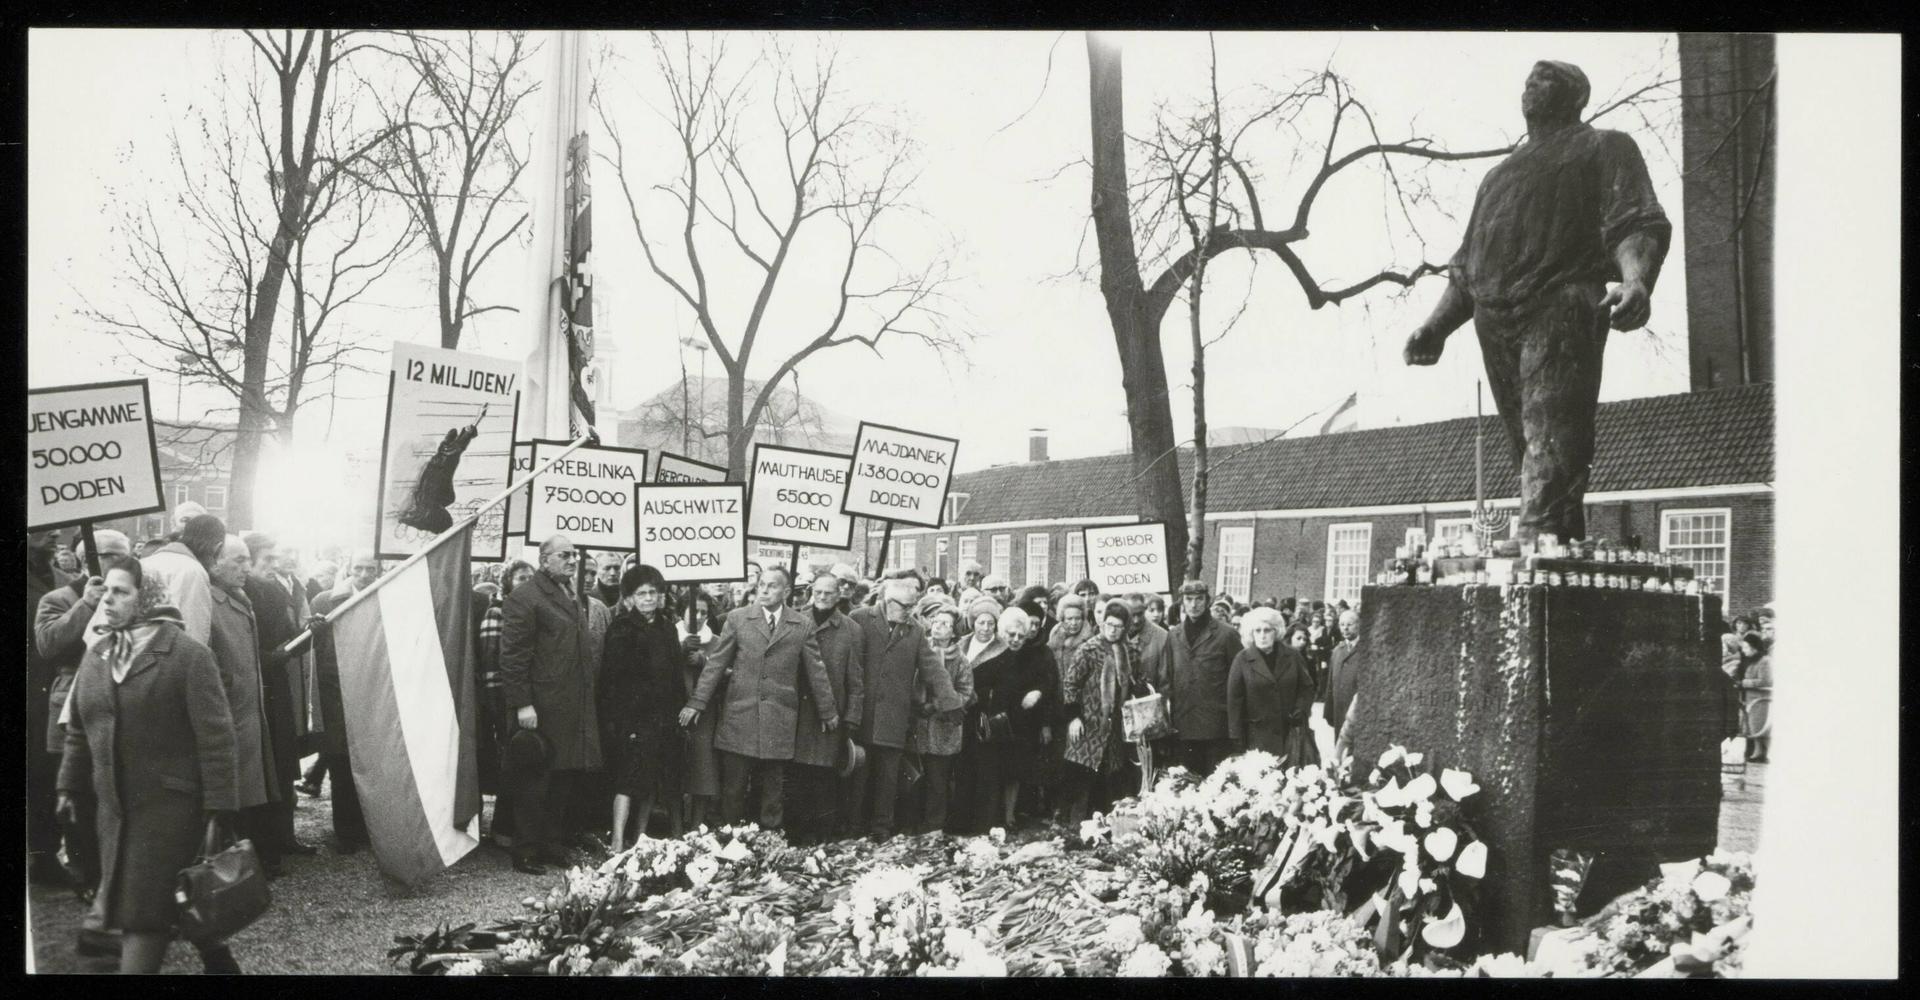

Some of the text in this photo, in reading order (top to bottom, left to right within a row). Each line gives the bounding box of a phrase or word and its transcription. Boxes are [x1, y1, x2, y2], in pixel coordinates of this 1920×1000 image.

[406, 358, 515, 396] 12 MILJOEN!
[32, 440, 122, 469] 50.000
[863, 438, 947, 466] MAJDANEK
[857, 462, 940, 489] 1.380.000
[41, 475, 125, 506] DODEN
[545, 485, 627, 507] 750.000
[869, 489, 920, 511] DODEN
[643, 499, 738, 515] AUSCHWITZ
[556, 514, 614, 533] DODEN
[773, 513, 829, 533] DODEN
[645, 526, 736, 542] 3.000.000
[1096, 533, 1154, 548] SOBIBOR
[664, 552, 720, 568] DODEN
[1107, 571, 1151, 586] DODEN
